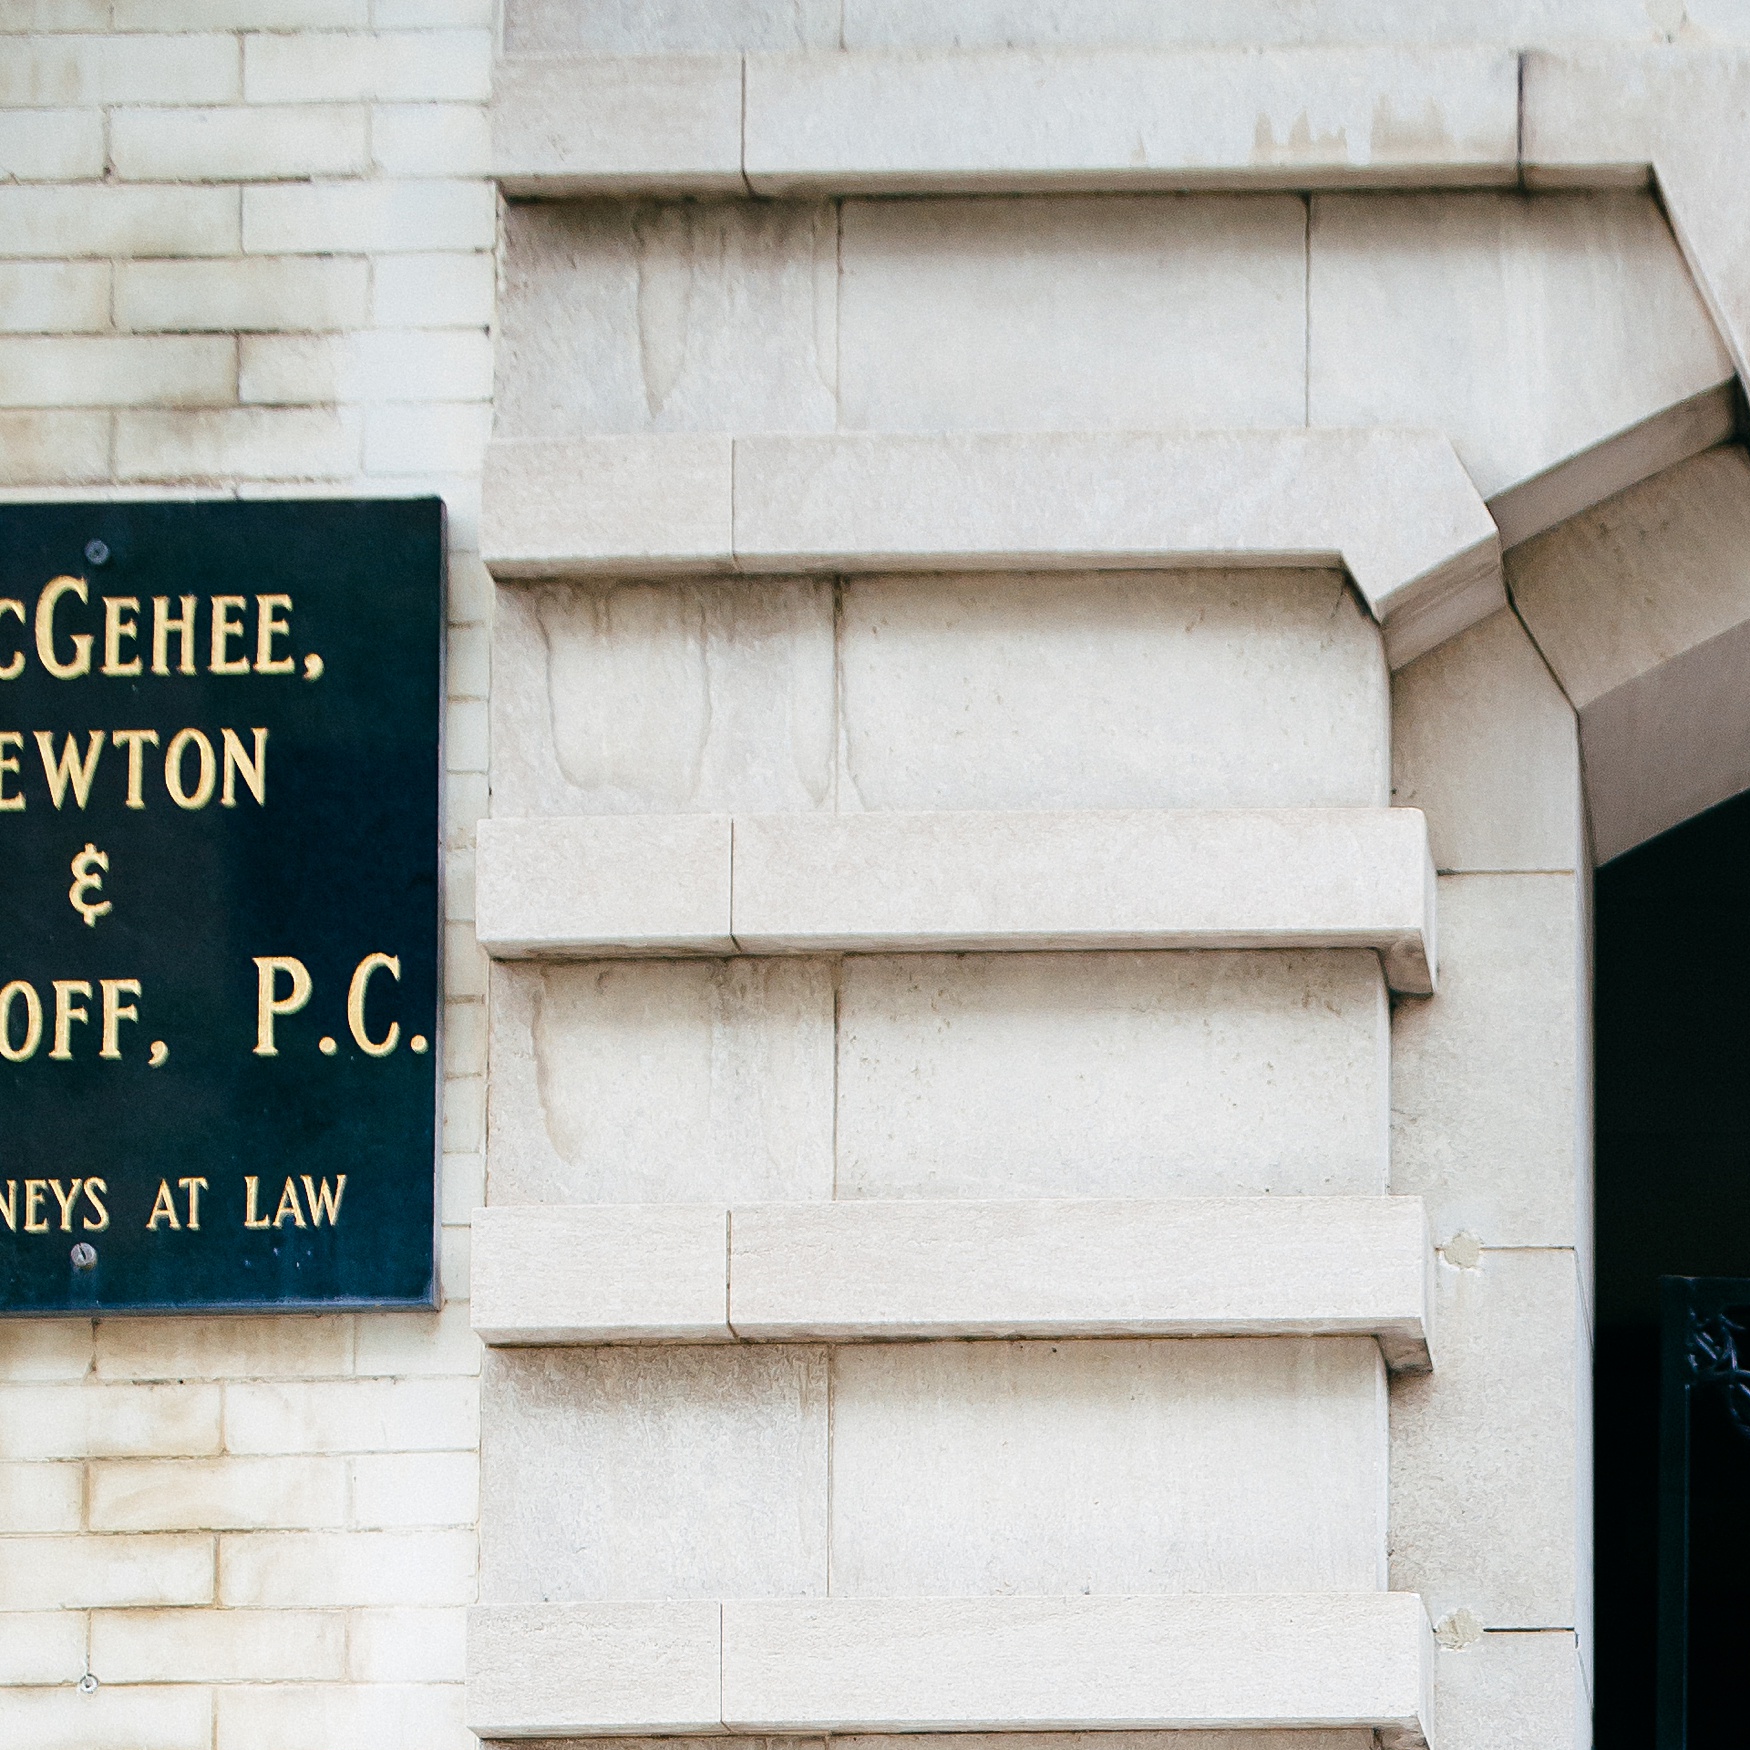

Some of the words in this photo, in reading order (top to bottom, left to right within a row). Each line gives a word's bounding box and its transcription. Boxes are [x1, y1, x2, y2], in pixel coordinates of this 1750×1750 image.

[0, 727, 268, 811] EWTON
[69, 843, 112, 928] &
[0, 979, 169, 1068] OFF,
[252, 952, 429, 1057] P.C.
[146, 1177, 209, 1231] AT
[244, 1174, 347, 1230] LAW
